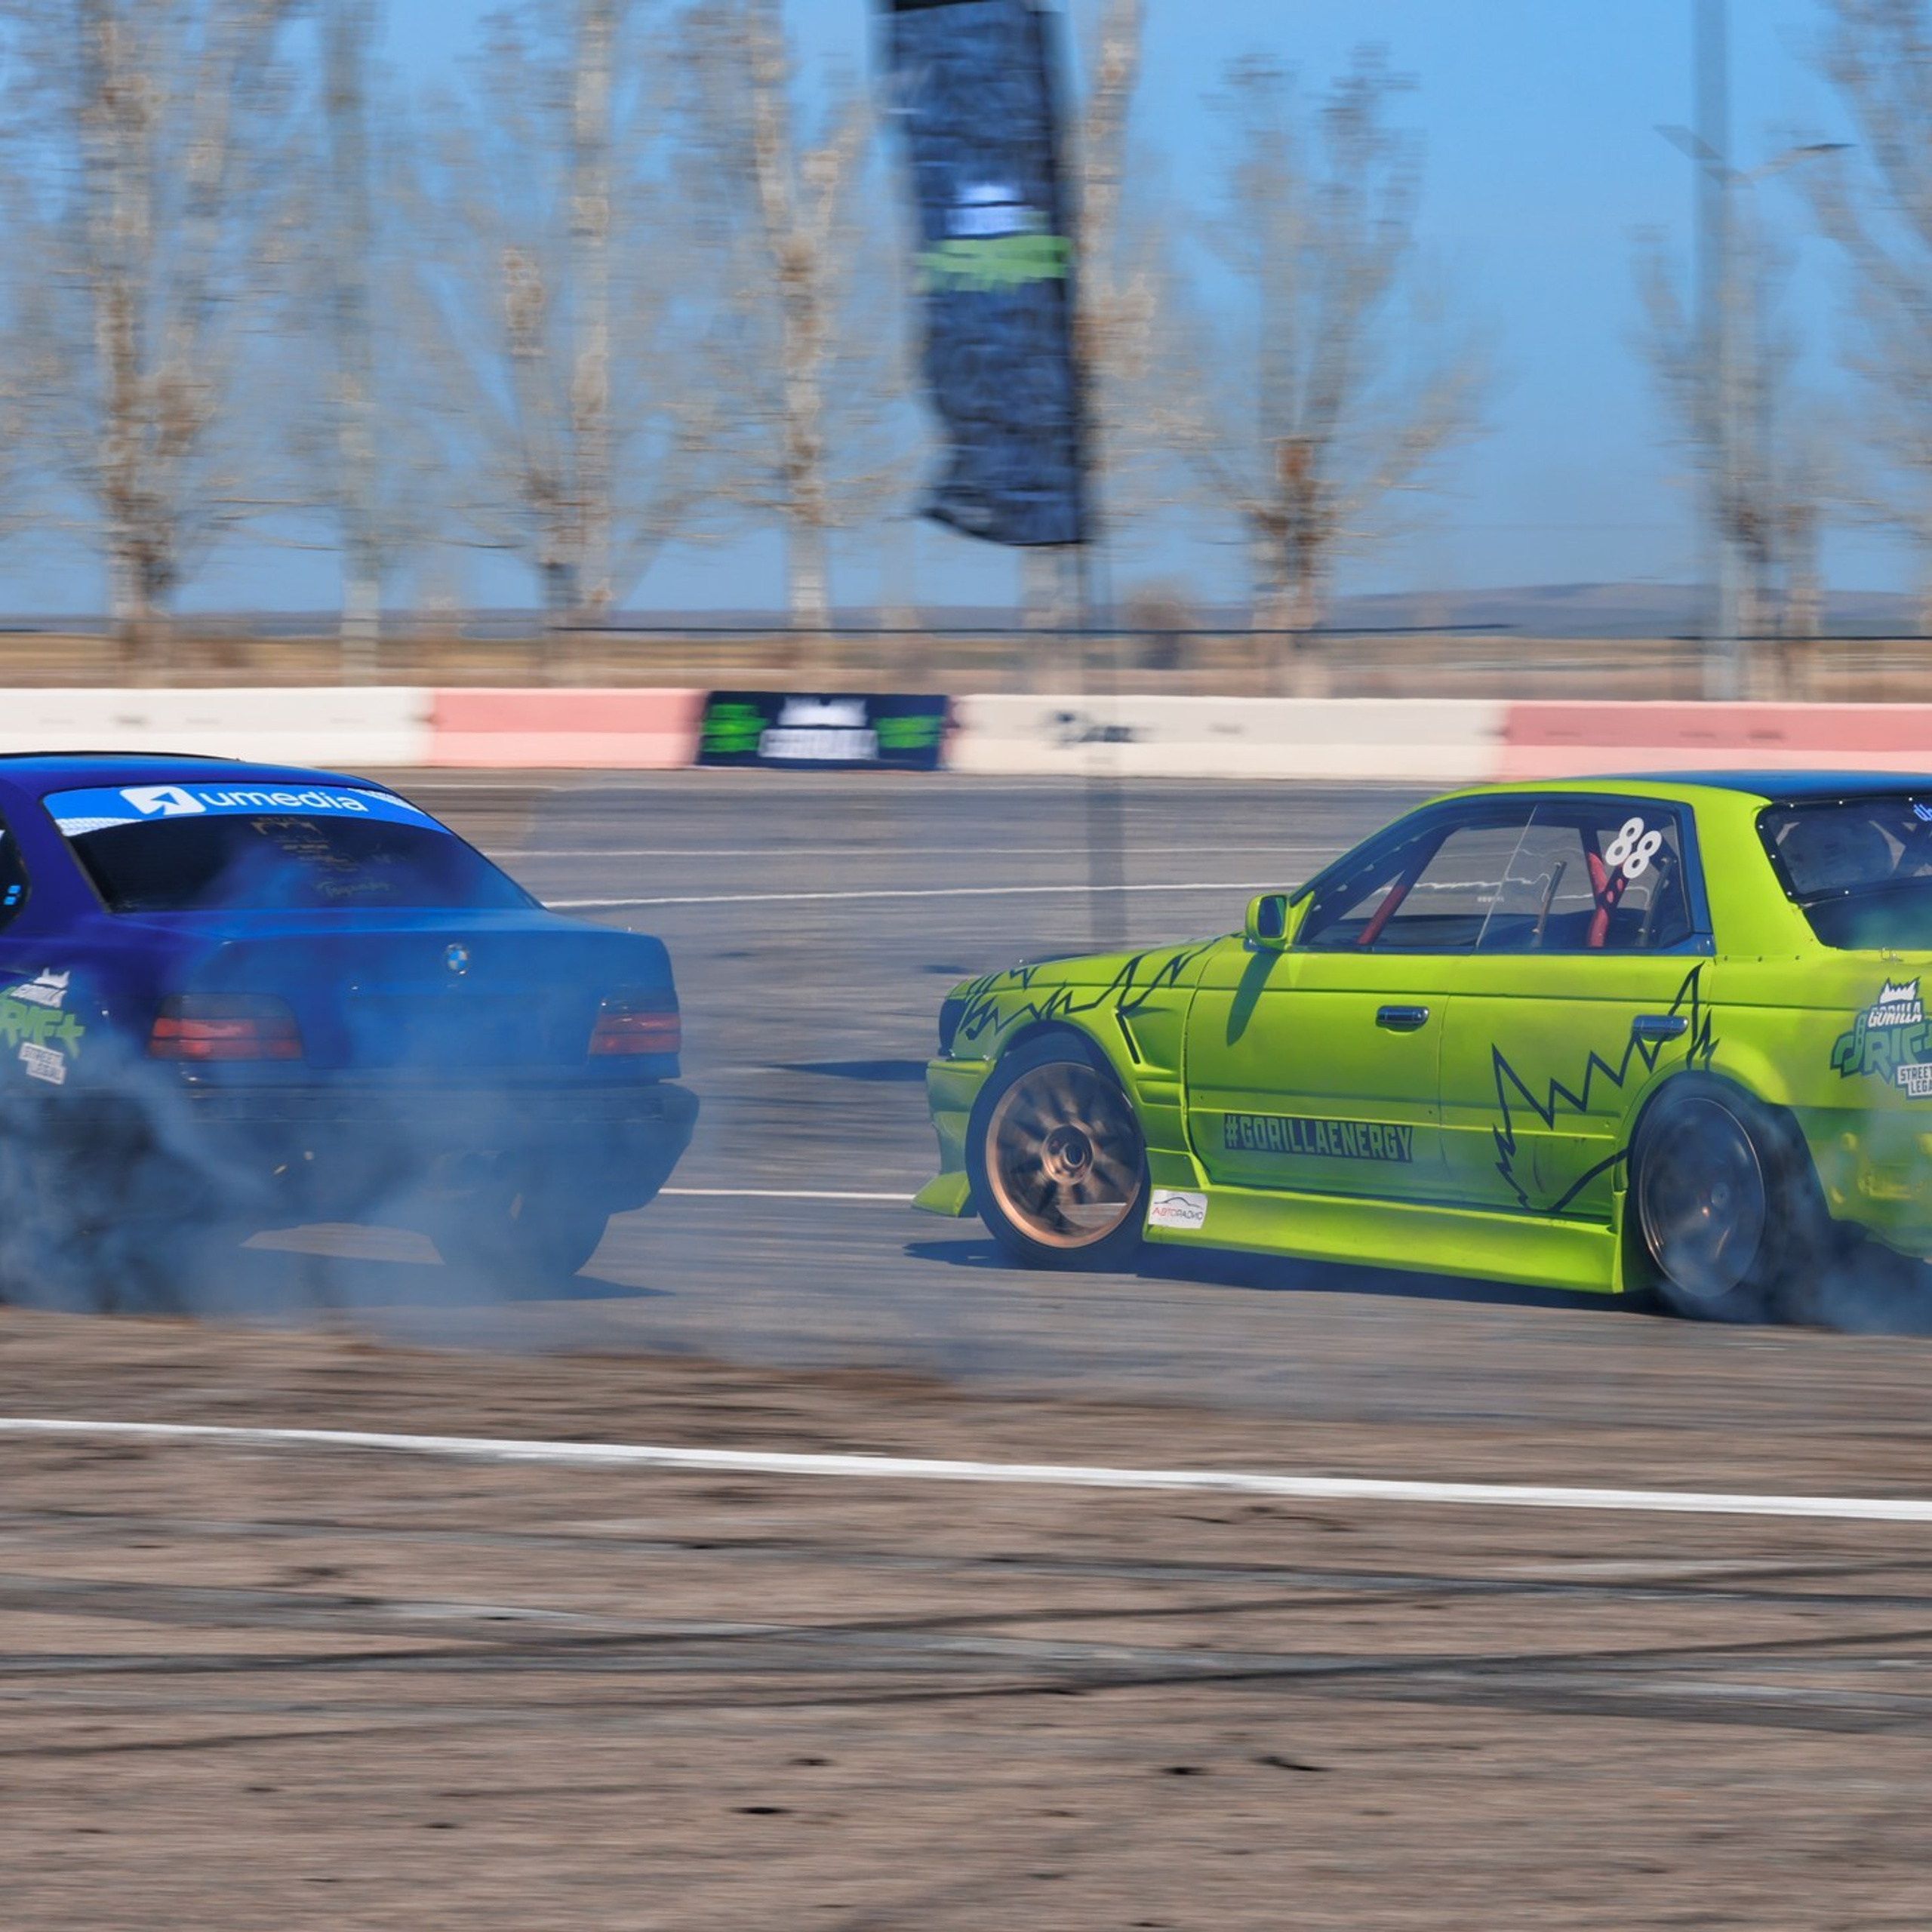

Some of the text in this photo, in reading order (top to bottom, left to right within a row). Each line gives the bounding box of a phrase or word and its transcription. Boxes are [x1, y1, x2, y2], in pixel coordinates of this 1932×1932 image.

[200, 791, 369, 812] umedia
[1605, 817, 1663, 879] 88
[1867, 1001, 1923, 1029] GORILLA
[1225, 1115, 1411, 1161] #GORILLAENERGY
